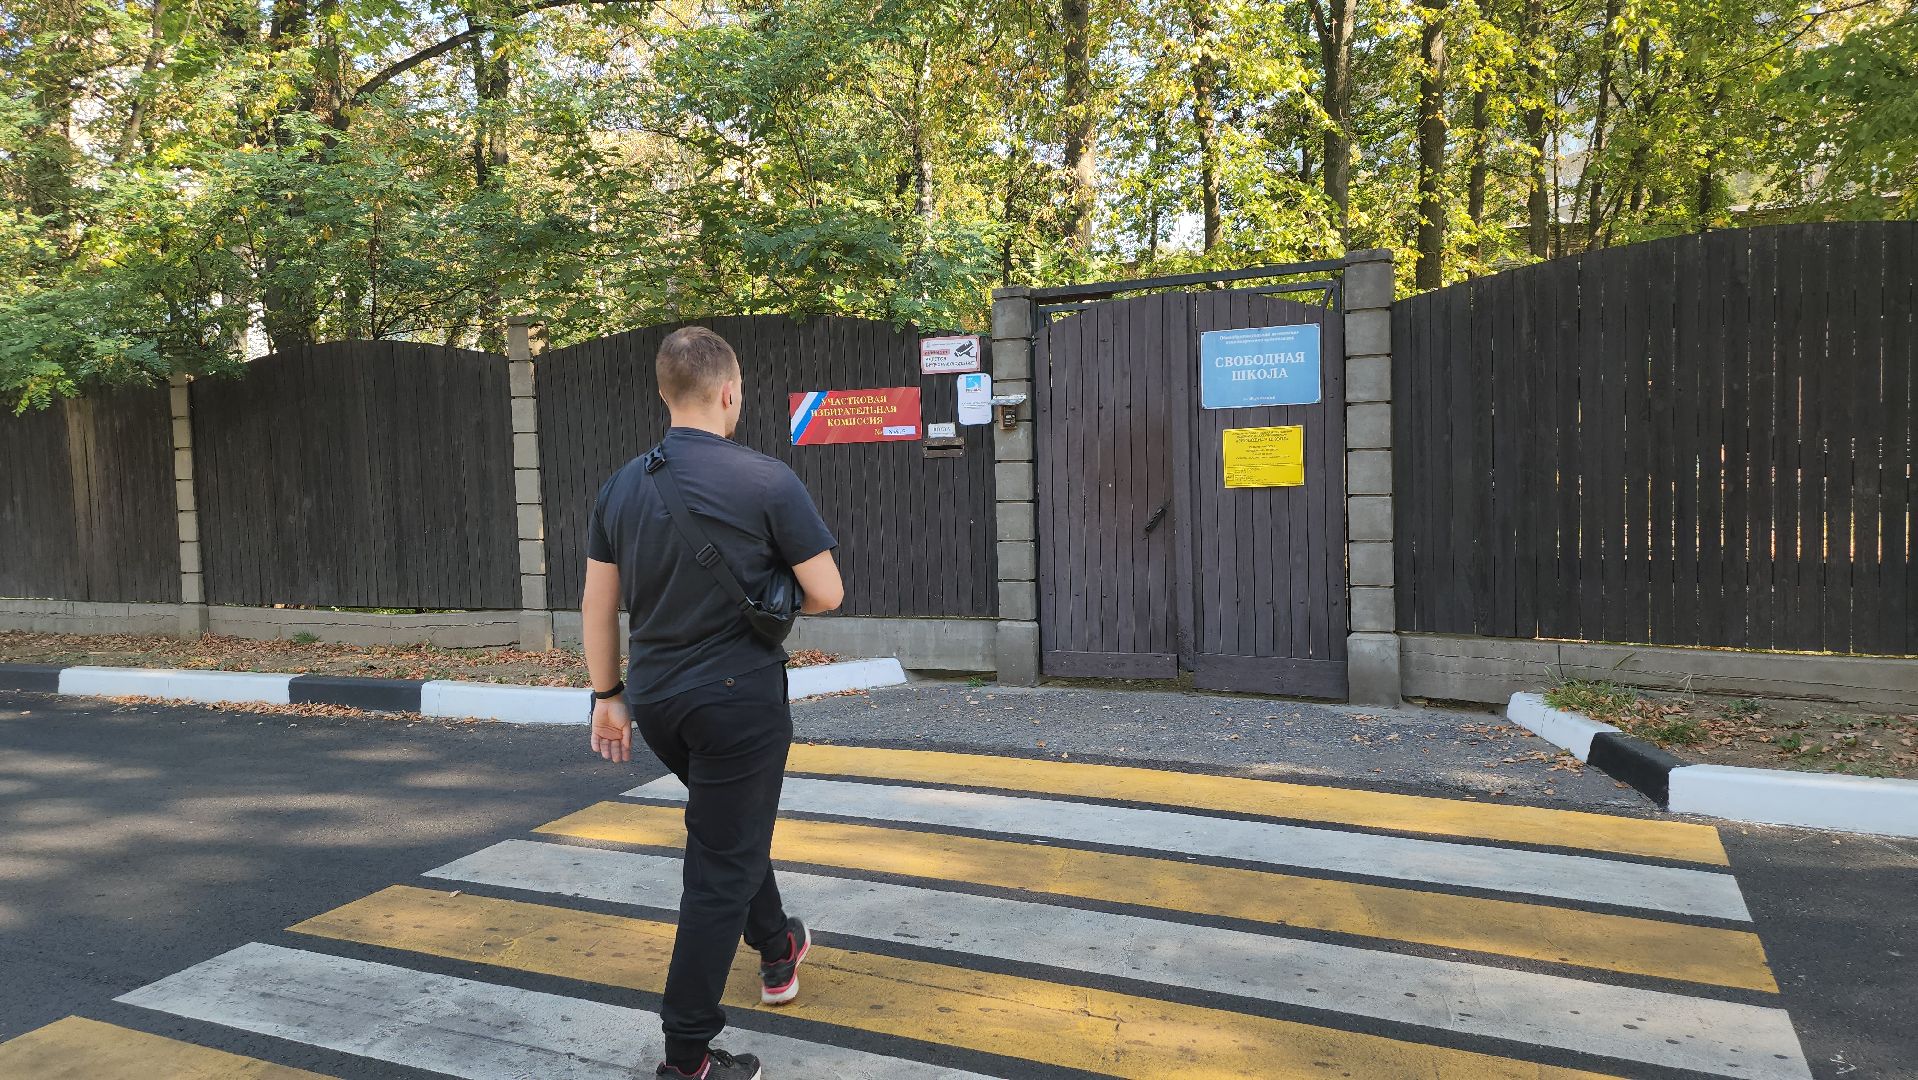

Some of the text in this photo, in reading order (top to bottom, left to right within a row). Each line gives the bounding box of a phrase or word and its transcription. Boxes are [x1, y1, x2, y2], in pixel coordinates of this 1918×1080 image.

[1215, 351, 1305, 368] СВОБОДНАЯ
[1231, 367, 1289, 381] ШКОЛА
[821, 395, 887, 406] УЧАСТКОВАЯ
[810, 406, 897, 417] ИЗБИРАТЕЛЬНАЯ
[827, 416, 883, 427] КОМИССИЯ
